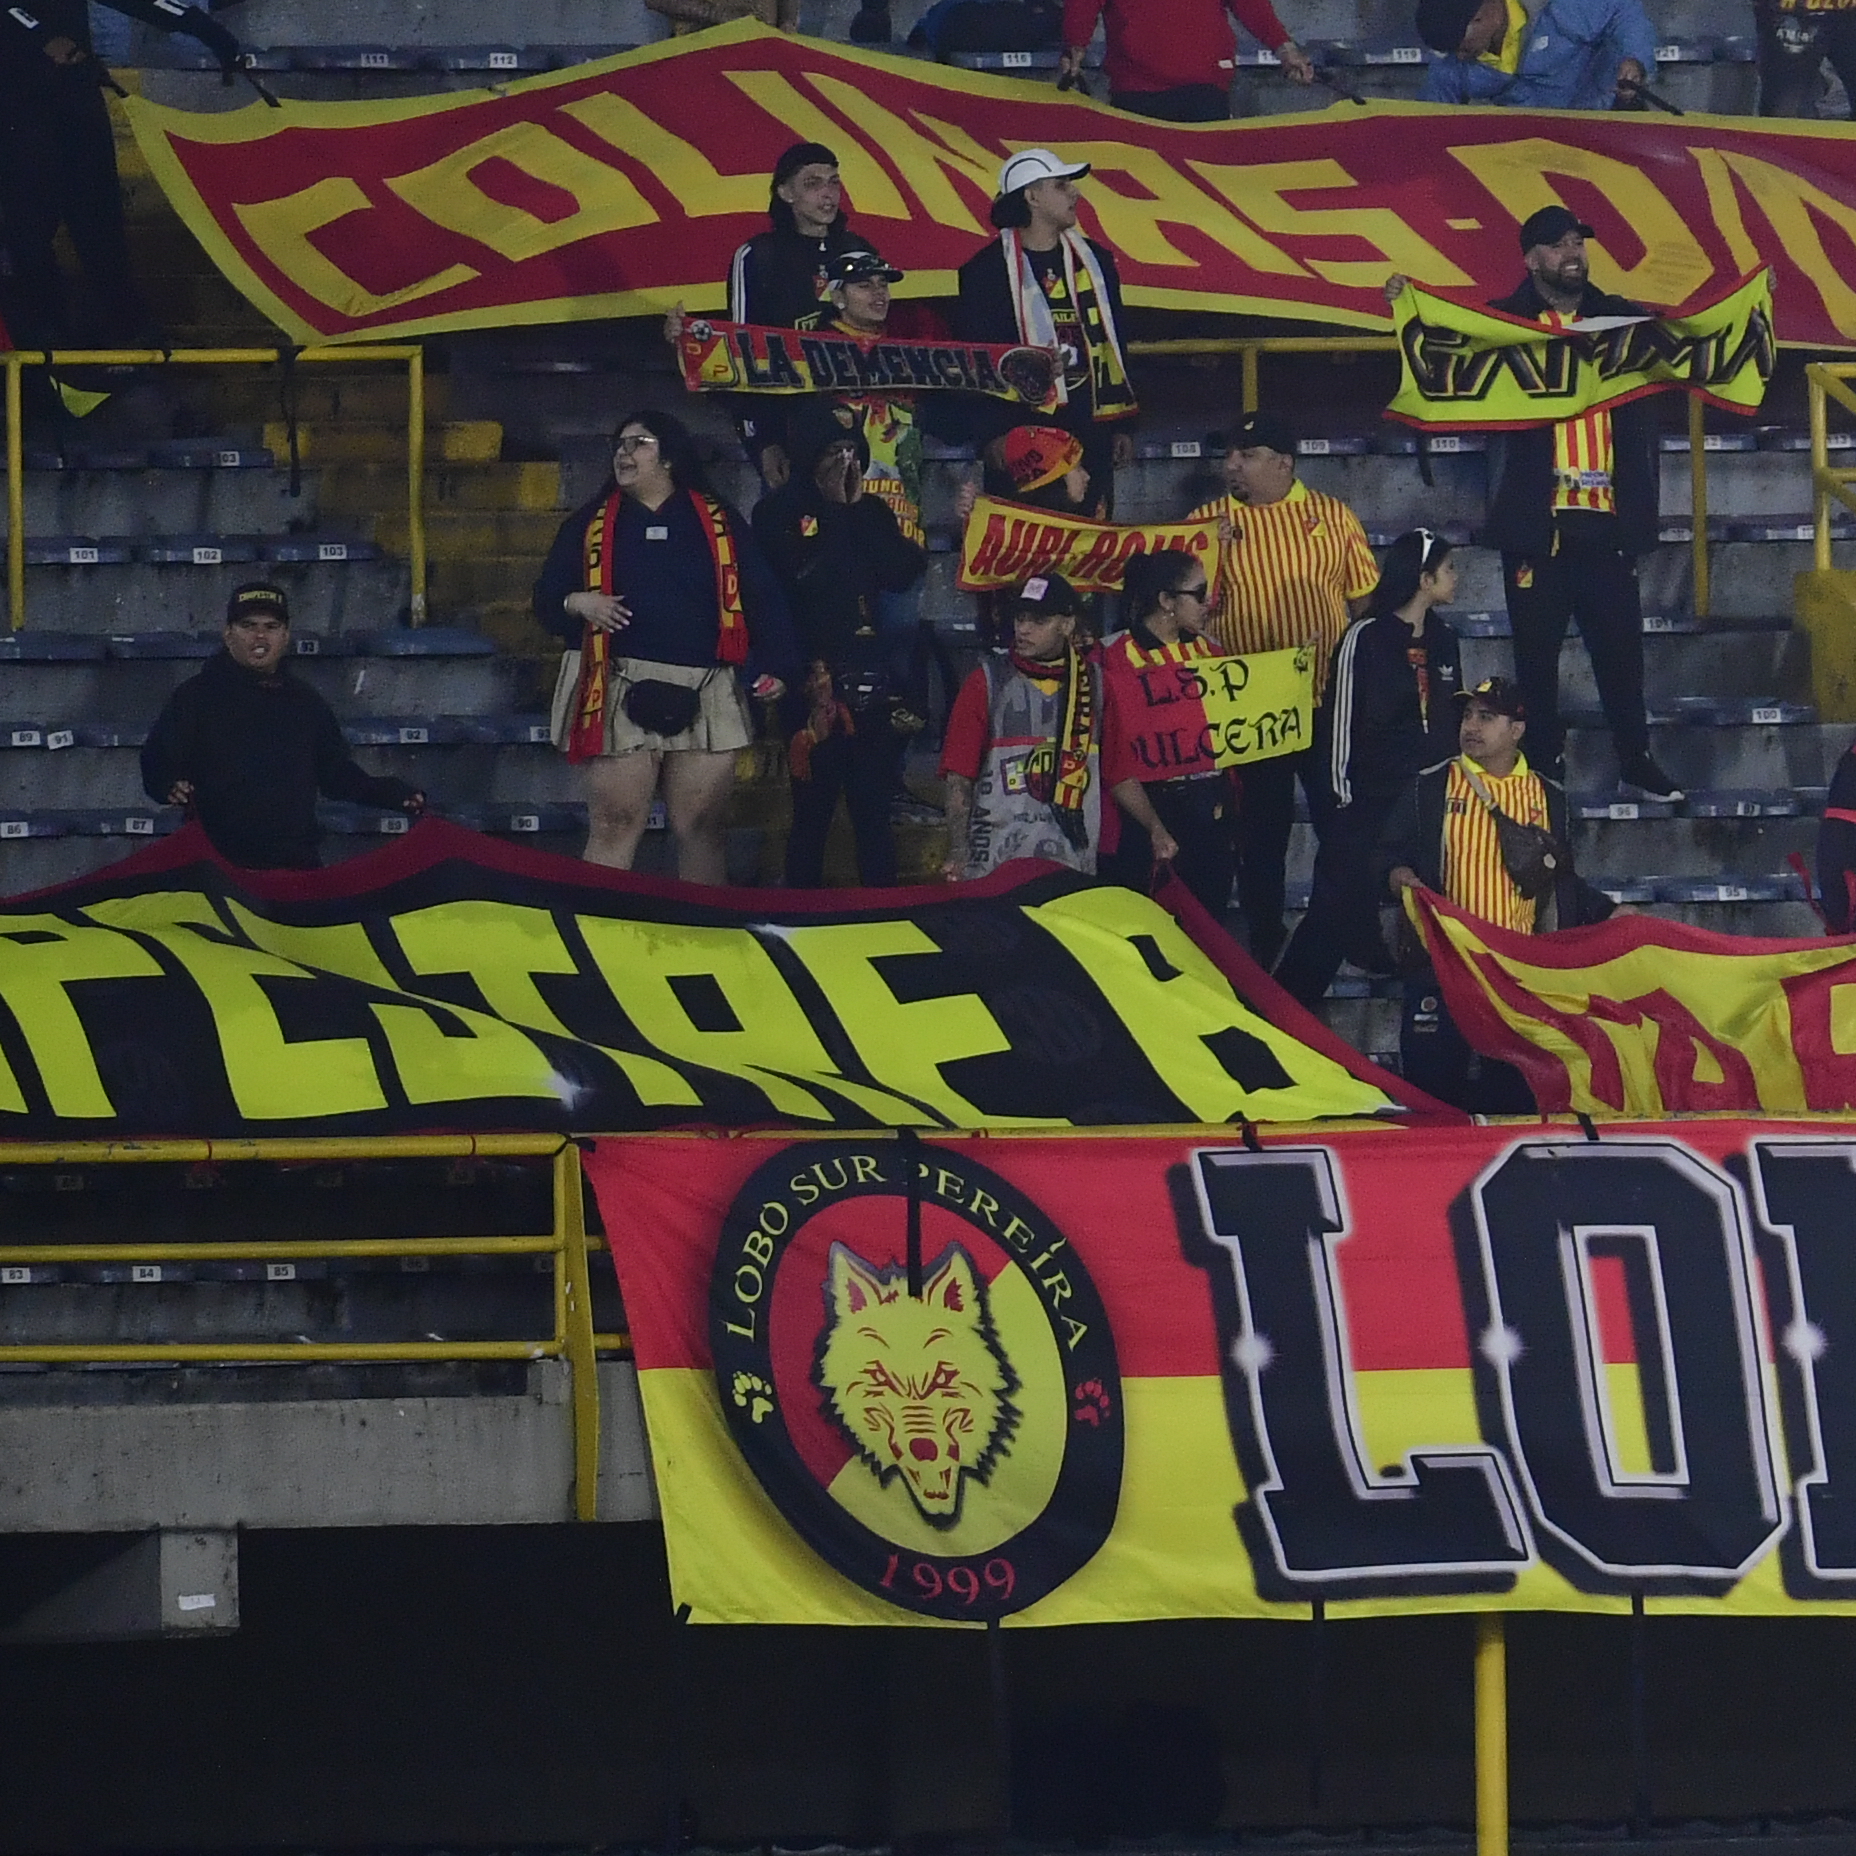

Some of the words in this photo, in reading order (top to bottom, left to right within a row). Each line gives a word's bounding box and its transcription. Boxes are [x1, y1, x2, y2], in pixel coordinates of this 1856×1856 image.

[492, 54, 515, 65] 112
[733, 327, 796, 385] LA
[802, 329, 996, 392] DEMENCIA
[74, 549, 95, 560] 101
[197, 550, 218, 561] 102
[322, 545, 344, 557] 103
[6, 823, 22, 835] 86
[132, 819, 148, 831] 87
[1725, 885, 1740, 897] 95
[0, 891, 1072, 1128] PESTRE
[1019, 888, 1406, 1128] B
[725, 1198, 790, 1342] LOBO
[789, 1154, 887, 1206] SUR
[6, 1267, 21, 1280] 83
[139, 1267, 154, 1279] 84
[273, 1265, 289, 1277] 85
[878, 1555, 1017, 1604] 1999
